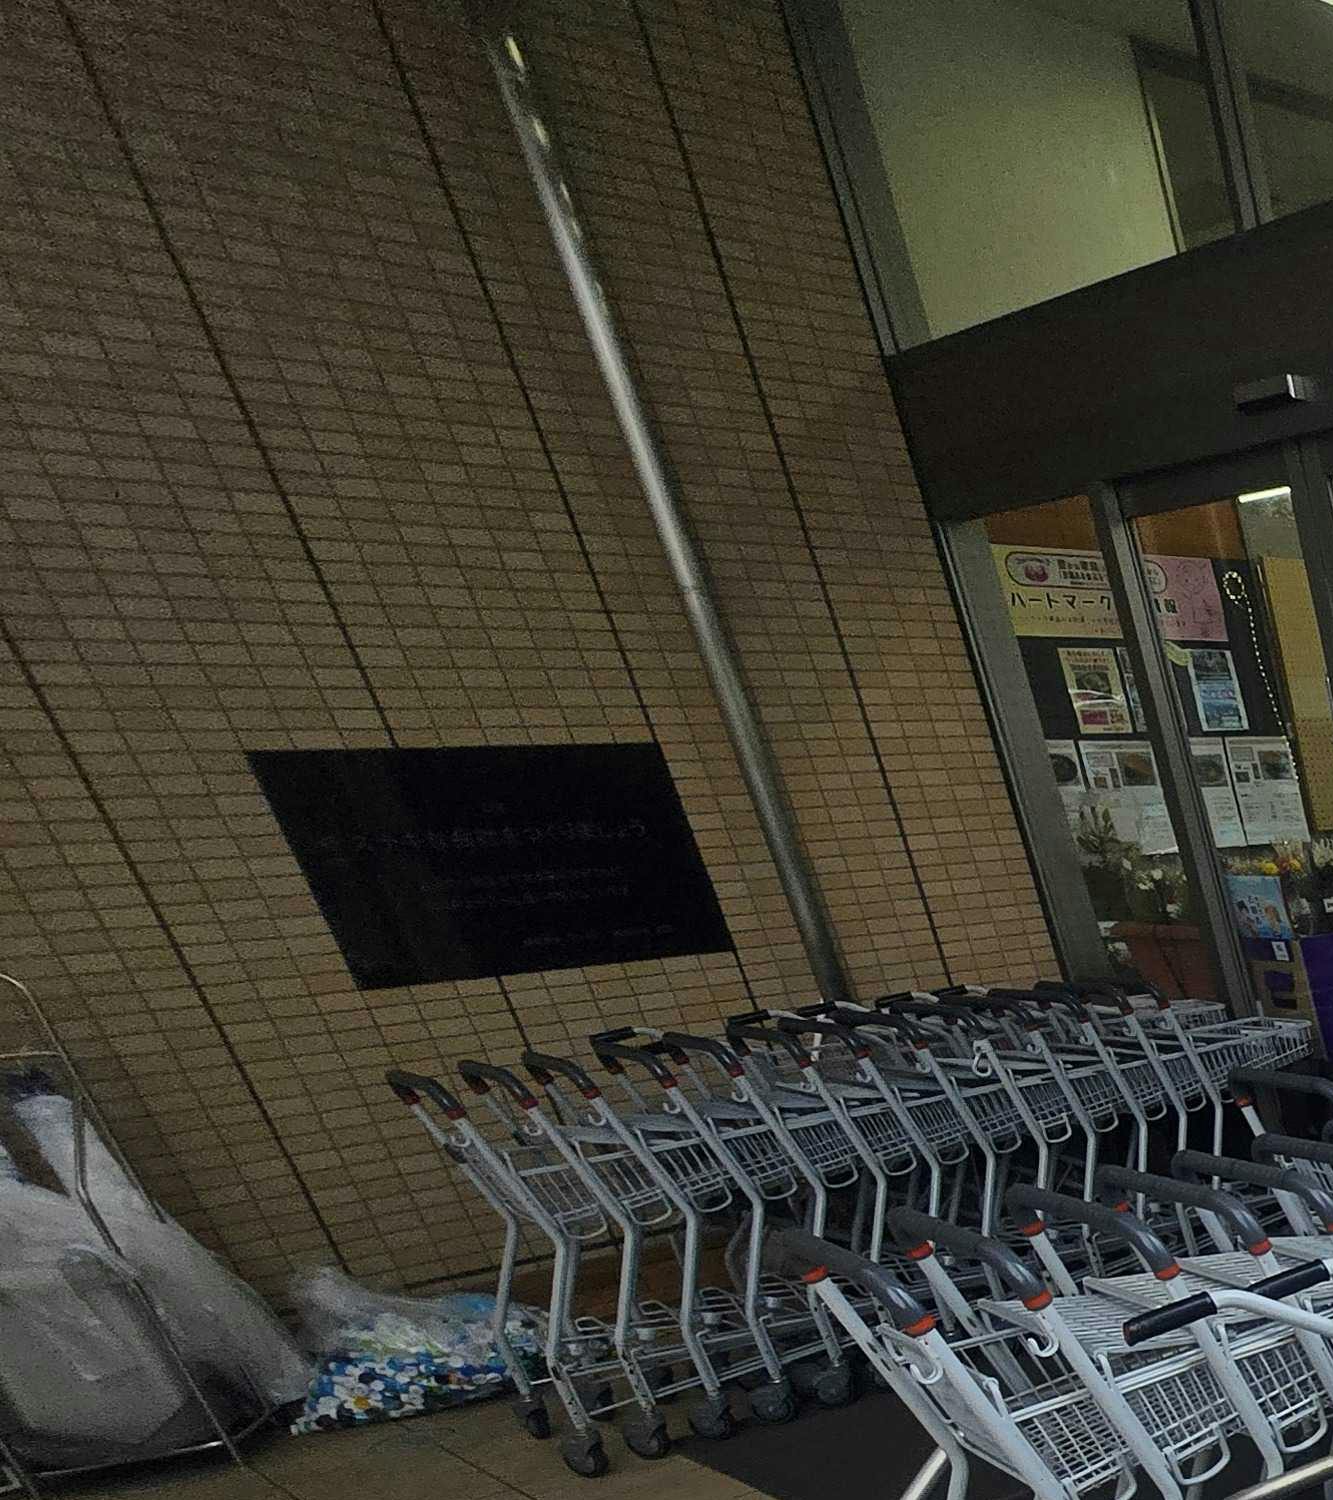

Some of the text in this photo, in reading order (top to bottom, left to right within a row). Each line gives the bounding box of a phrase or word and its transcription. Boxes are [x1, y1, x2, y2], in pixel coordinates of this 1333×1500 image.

[1010, 592, 1111, 612] ハートマーク
